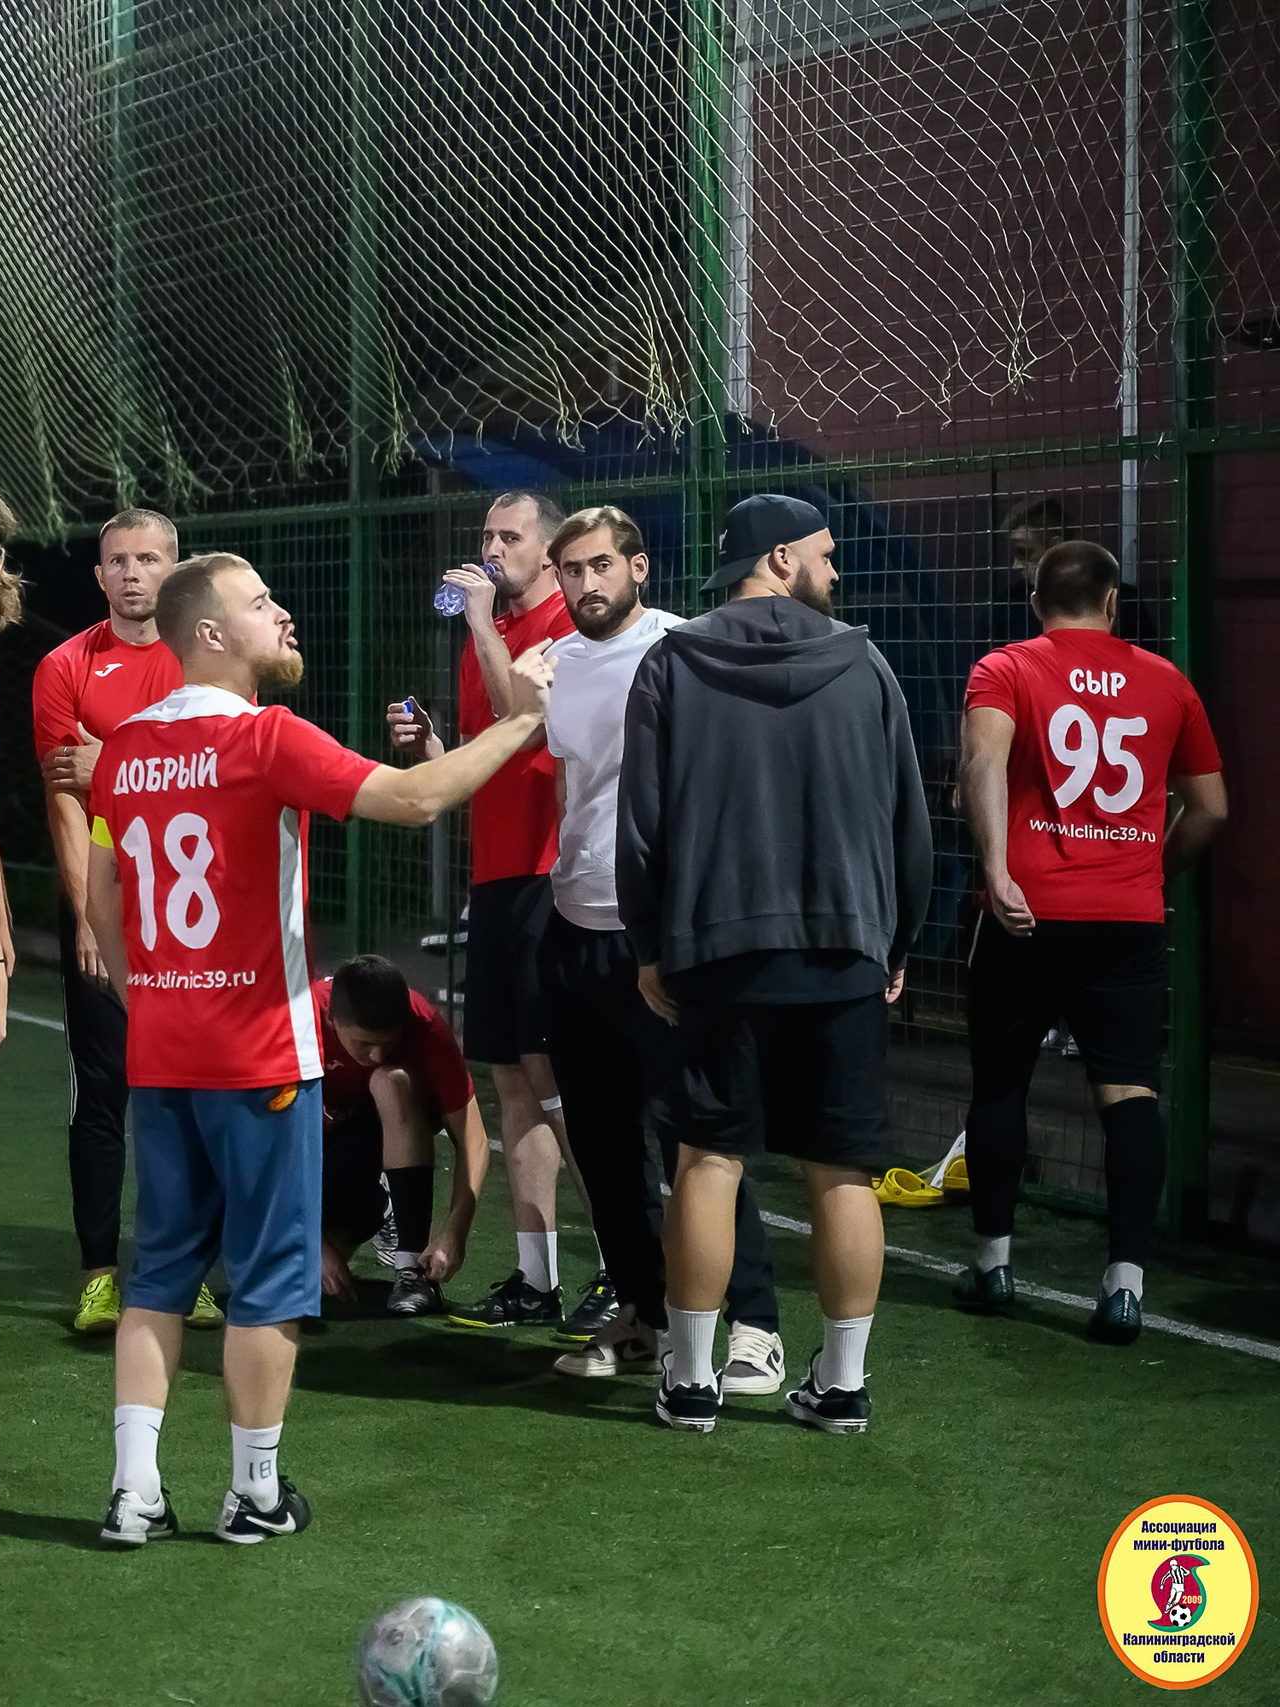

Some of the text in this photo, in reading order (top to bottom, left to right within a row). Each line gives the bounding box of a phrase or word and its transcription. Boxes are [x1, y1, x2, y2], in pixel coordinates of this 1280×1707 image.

[1069, 667, 1127, 697] СЫР
[113, 746, 219, 795] ДОБРЫЙ
[1048, 703, 1148, 814] 95
[1029, 819, 1157, 843] www.lclinic39.ru
[120, 812, 221, 952] 18
